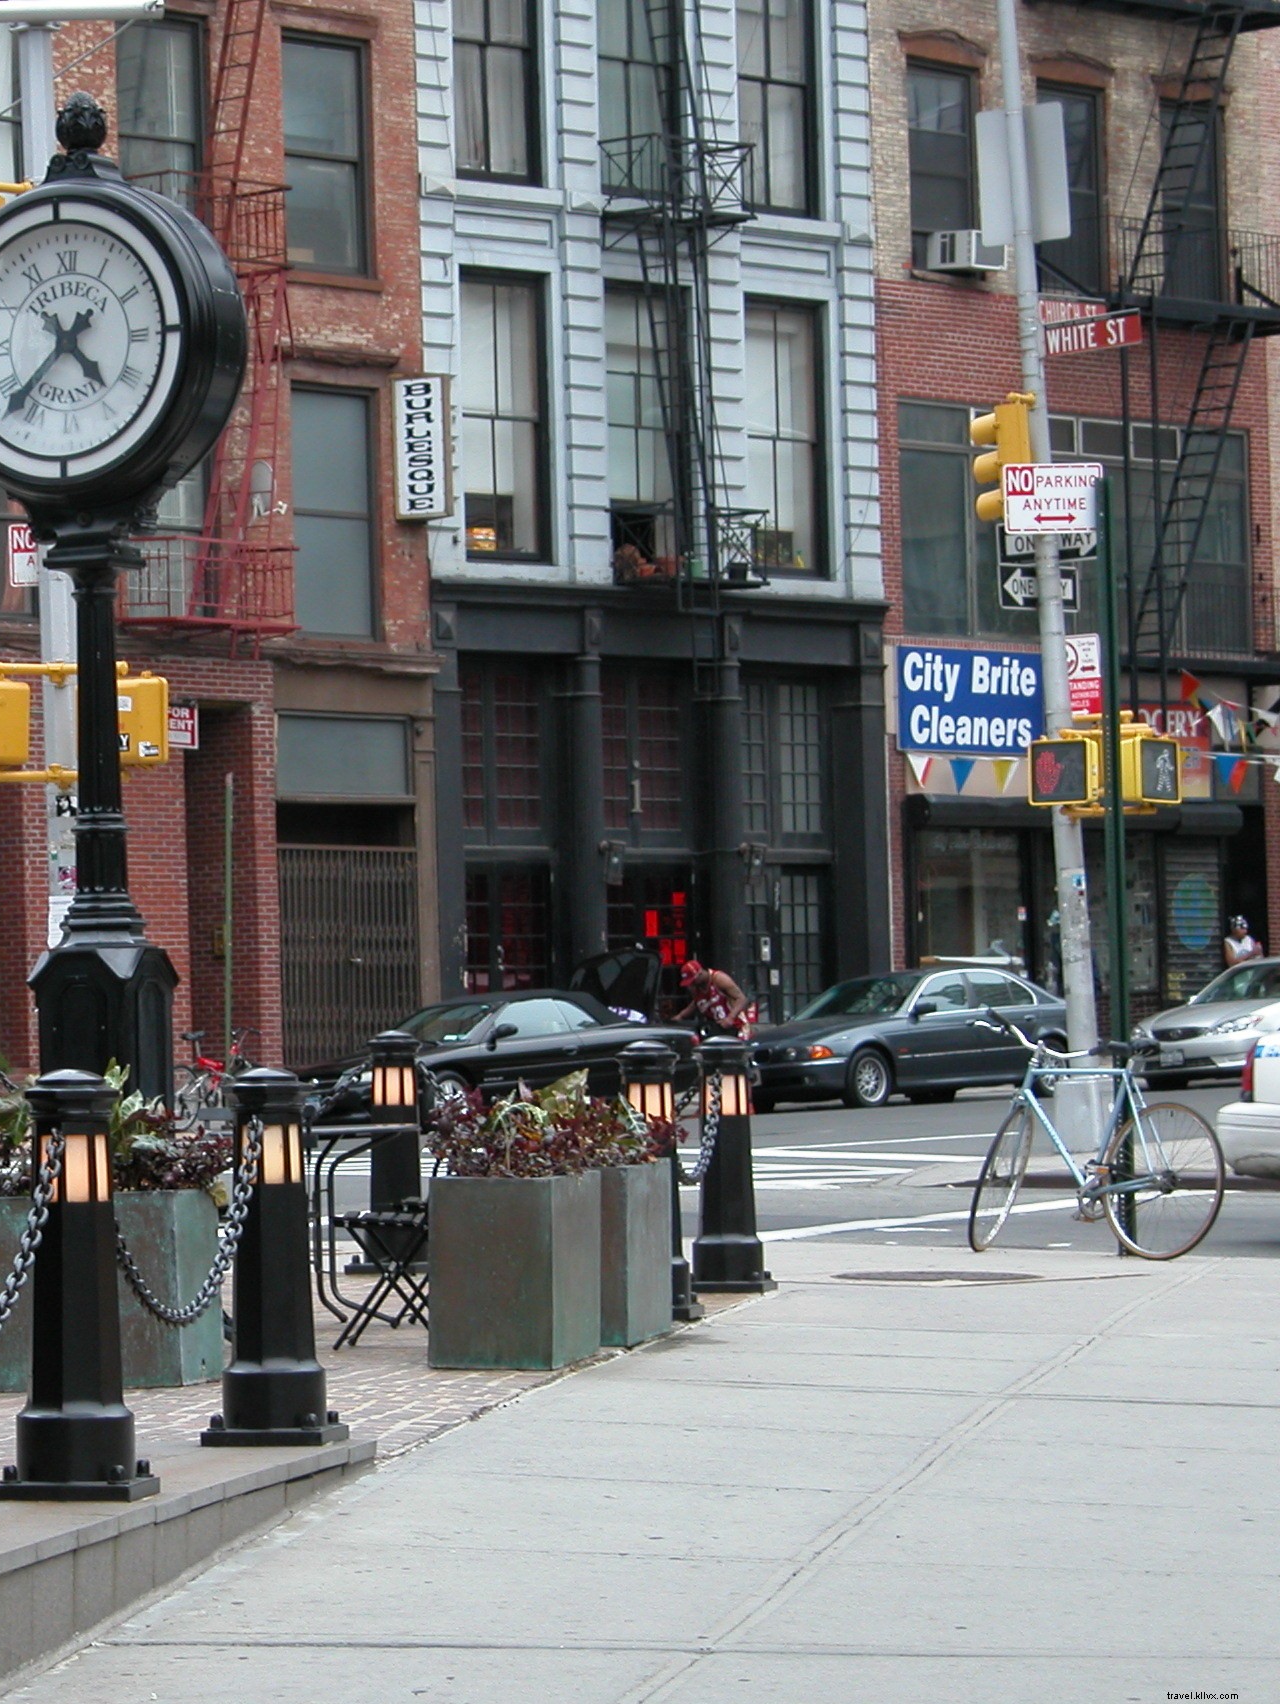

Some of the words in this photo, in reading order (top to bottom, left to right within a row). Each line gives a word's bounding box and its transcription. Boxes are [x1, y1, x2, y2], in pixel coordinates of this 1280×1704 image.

[56, 250, 78, 274] XII
[22, 263, 43, 290] XI
[25, 280, 108, 314] TRIBECA
[1040, 299, 1080, 322] CHURCH
[1084, 303, 1097, 318] ST
[1046, 322, 1097, 355] WHITE
[1105, 317, 1126, 345] ST
[38, 380, 102, 405] GRAND
[403, 381, 435, 512] BURLESQUE
[1007, 469, 1033, 493] NO
[1035, 475, 1097, 488] PARKING
[1022, 498, 1087, 511] ANYTIME
[1014, 534, 1035, 553] ON
[1061, 533, 1093, 548] WAY
[1011, 578, 1035, 595] ONE
[903, 651, 961, 703] City
[971, 656, 1037, 696] Brite
[1069, 679, 1099, 690] TANDING
[169, 718, 194, 731] ENT
[909, 704, 1032, 748] Cleaners
